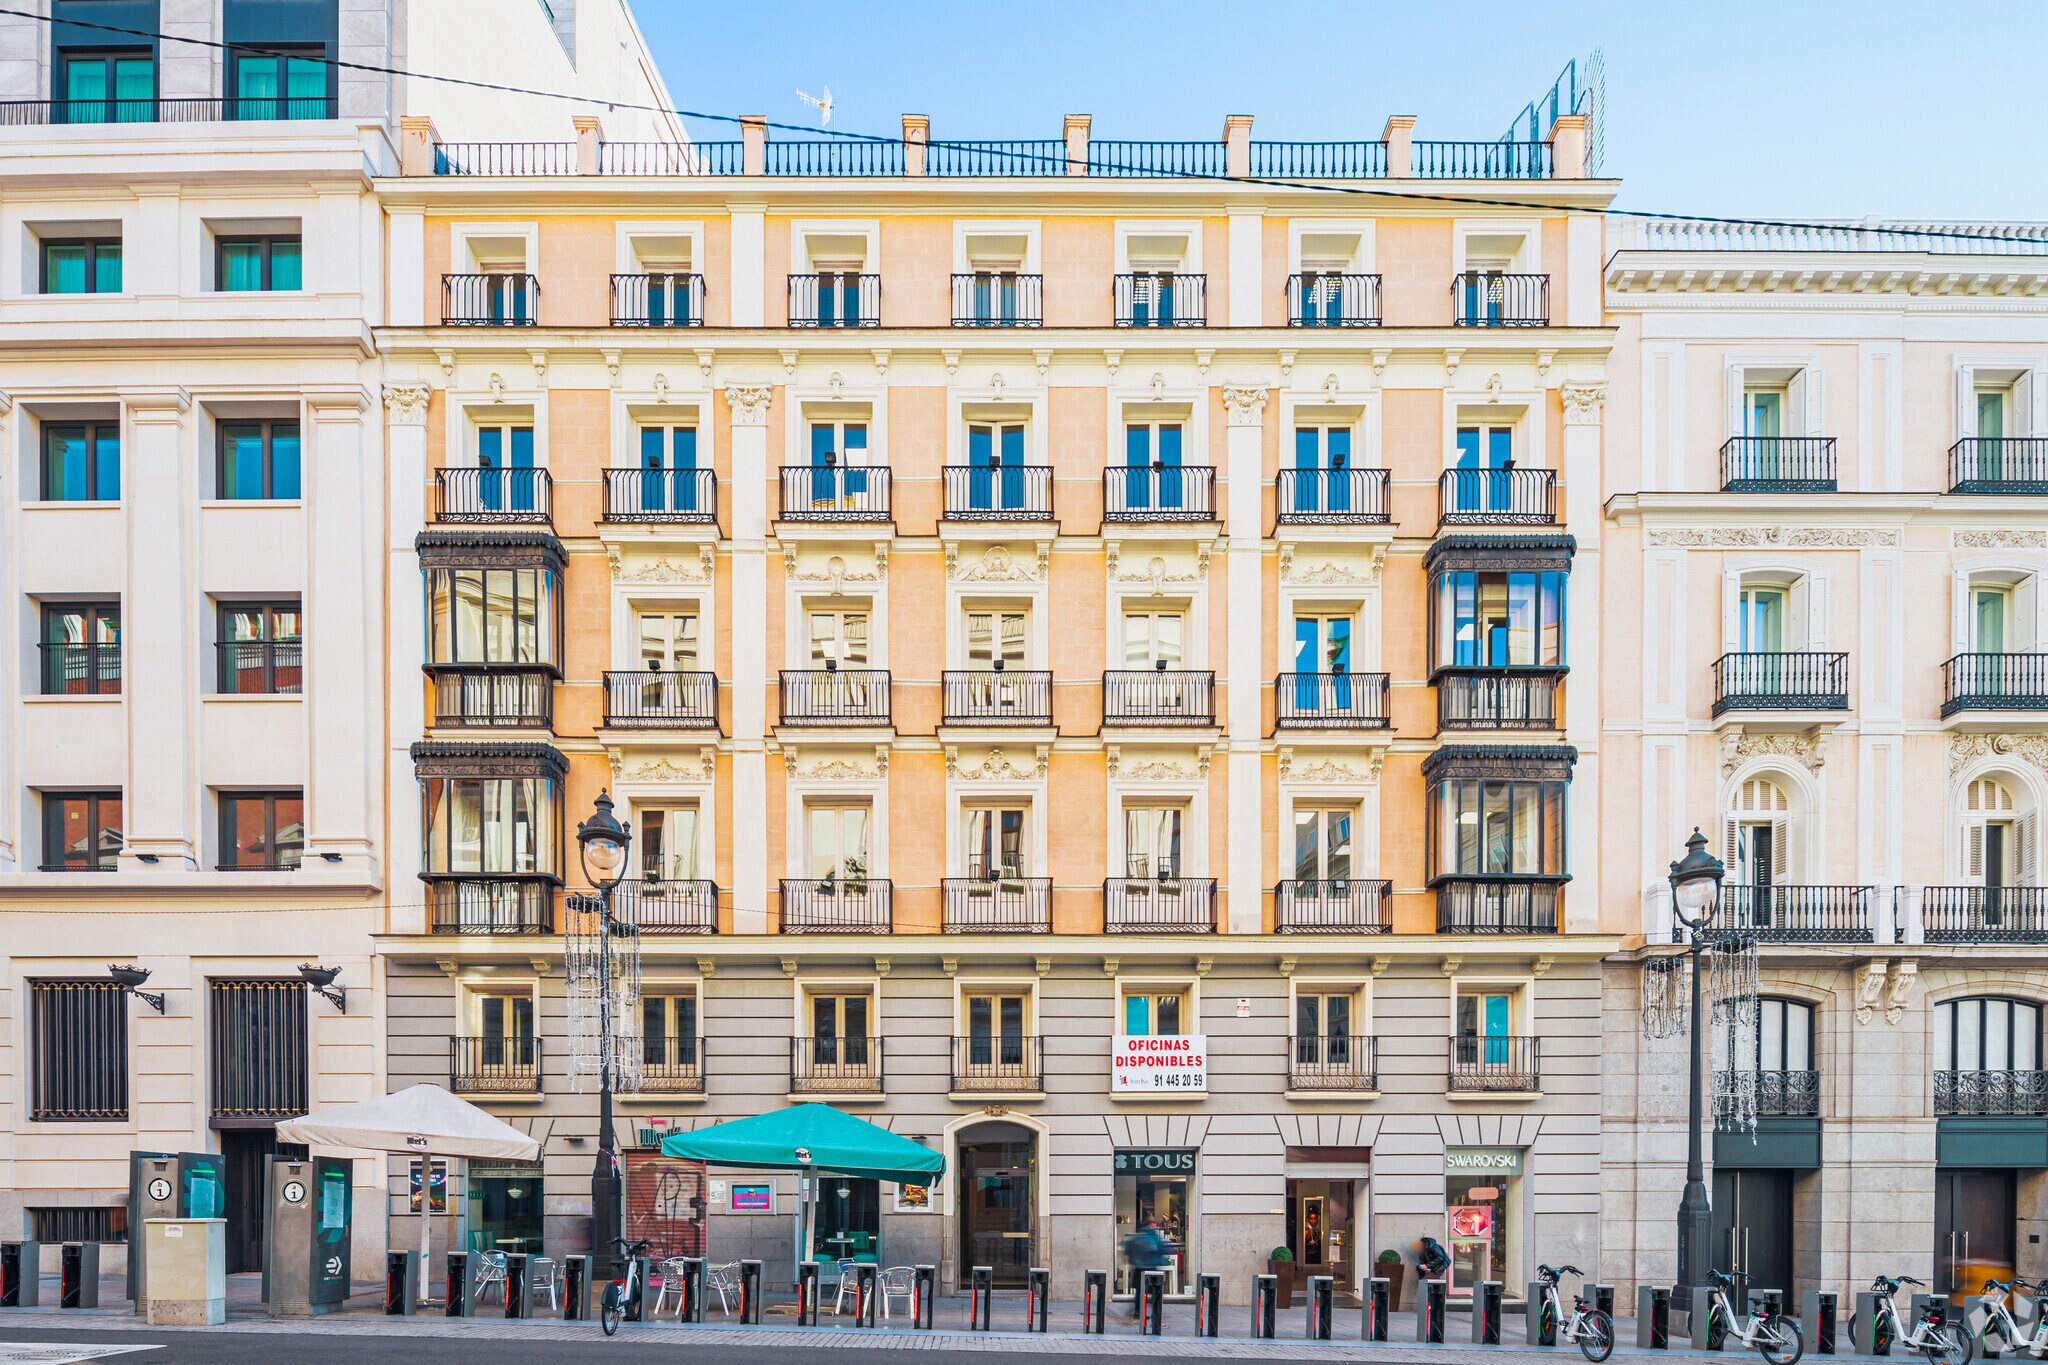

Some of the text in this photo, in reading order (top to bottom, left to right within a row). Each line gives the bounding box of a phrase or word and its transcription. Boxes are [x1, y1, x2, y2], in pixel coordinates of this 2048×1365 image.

[1128, 1040, 1190, 1051] OFICINAS
[1115, 1056, 1203, 1067] DISPONIBLES
[1154, 1074, 1163, 1086] 91
[1166, 1074, 1180, 1086] 445
[1182, 1074, 1191, 1086] 20
[1193, 1074, 1203, 1086] 59
[1131, 1154, 1194, 1169] TOUS
[1446, 1154, 1517, 1168] SWAROVSKI
